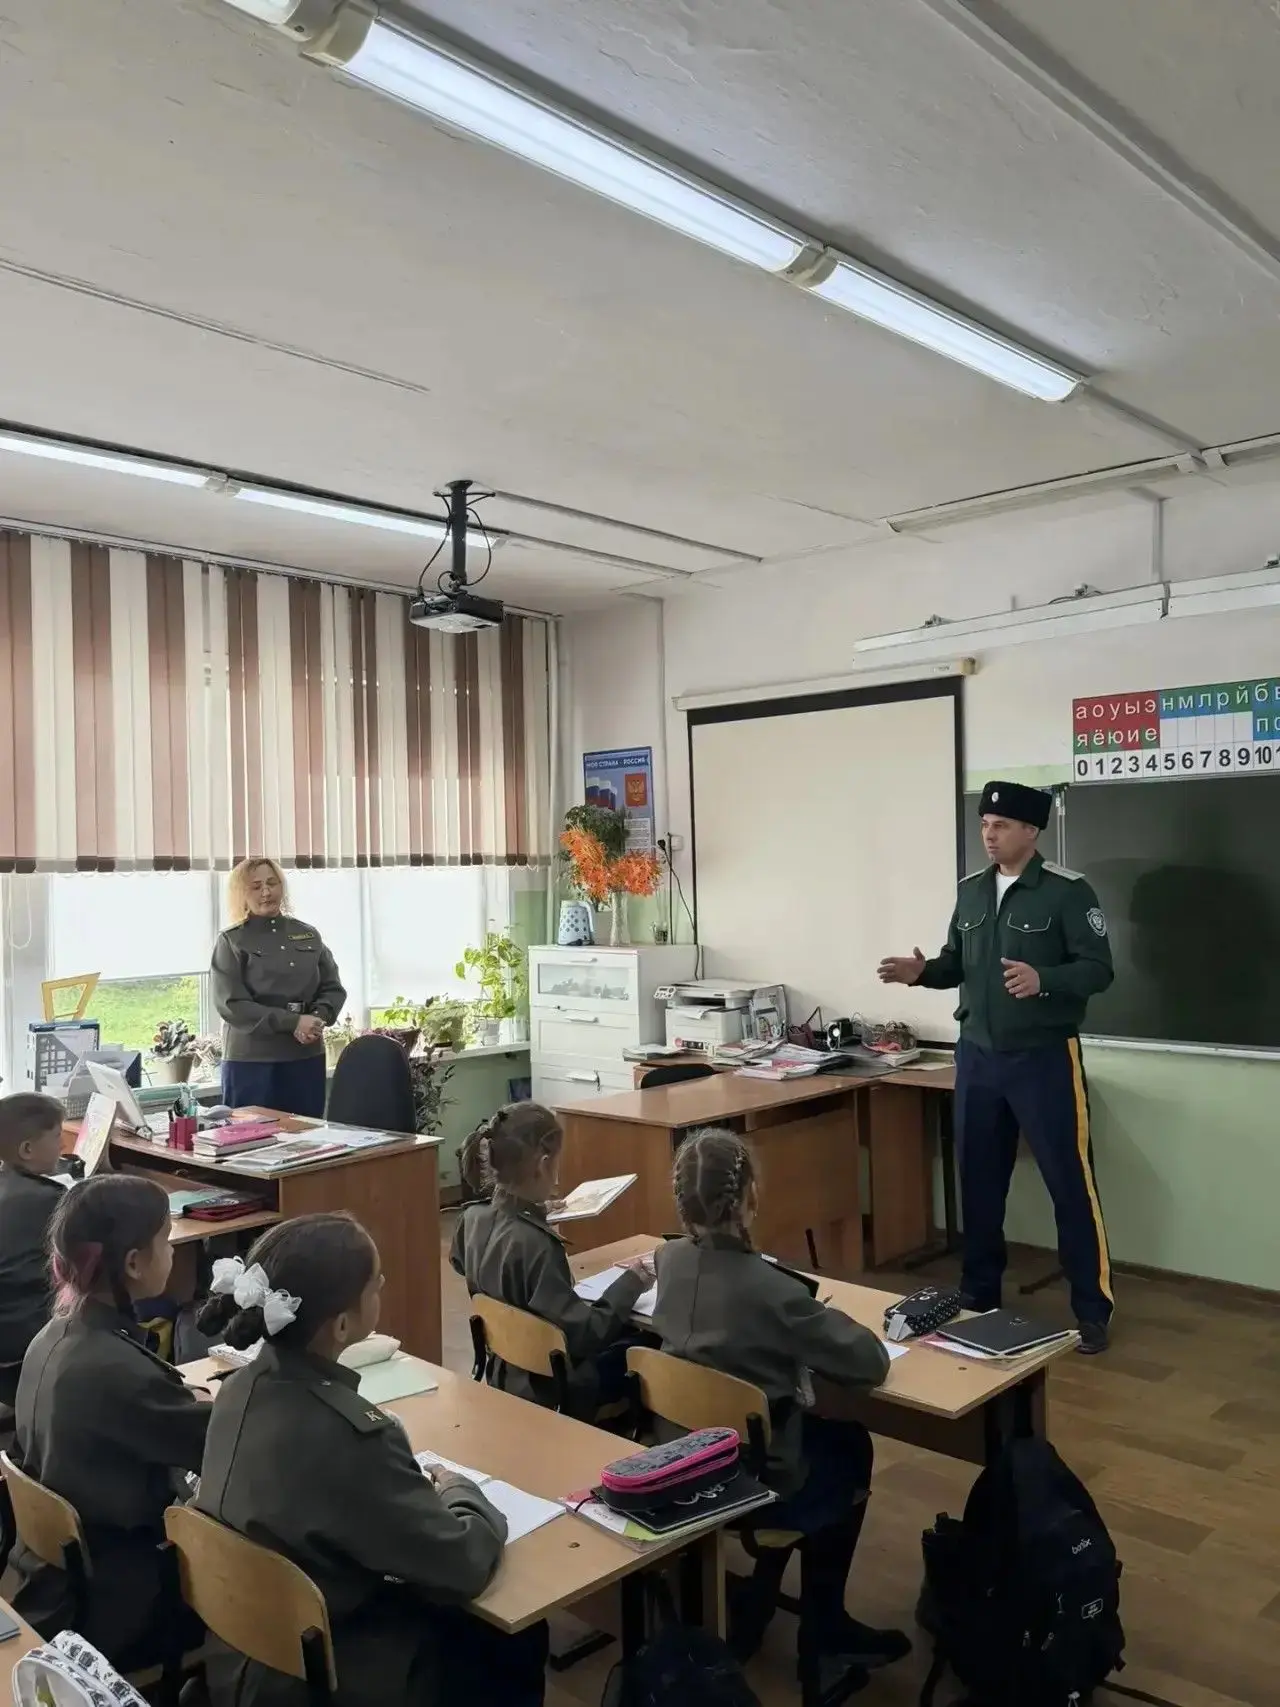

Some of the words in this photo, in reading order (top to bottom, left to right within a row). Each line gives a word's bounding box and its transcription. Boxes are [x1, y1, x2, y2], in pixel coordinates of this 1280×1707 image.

[1078, 760, 1087, 775] 0
[1096, 759, 1103, 775] 1
[1112, 758, 1122, 773] 2
[1129, 756, 1139, 772] 3
[1146, 755, 1157, 771] 4
[1164, 753, 1175, 770] 5
[1182, 752, 1193, 768] 6
[1200, 751, 1211, 767] 7
[1219, 750, 1230, 766] 8
[1238, 748, 1250, 765] 9
[1255, 746, 1271, 764] 10
